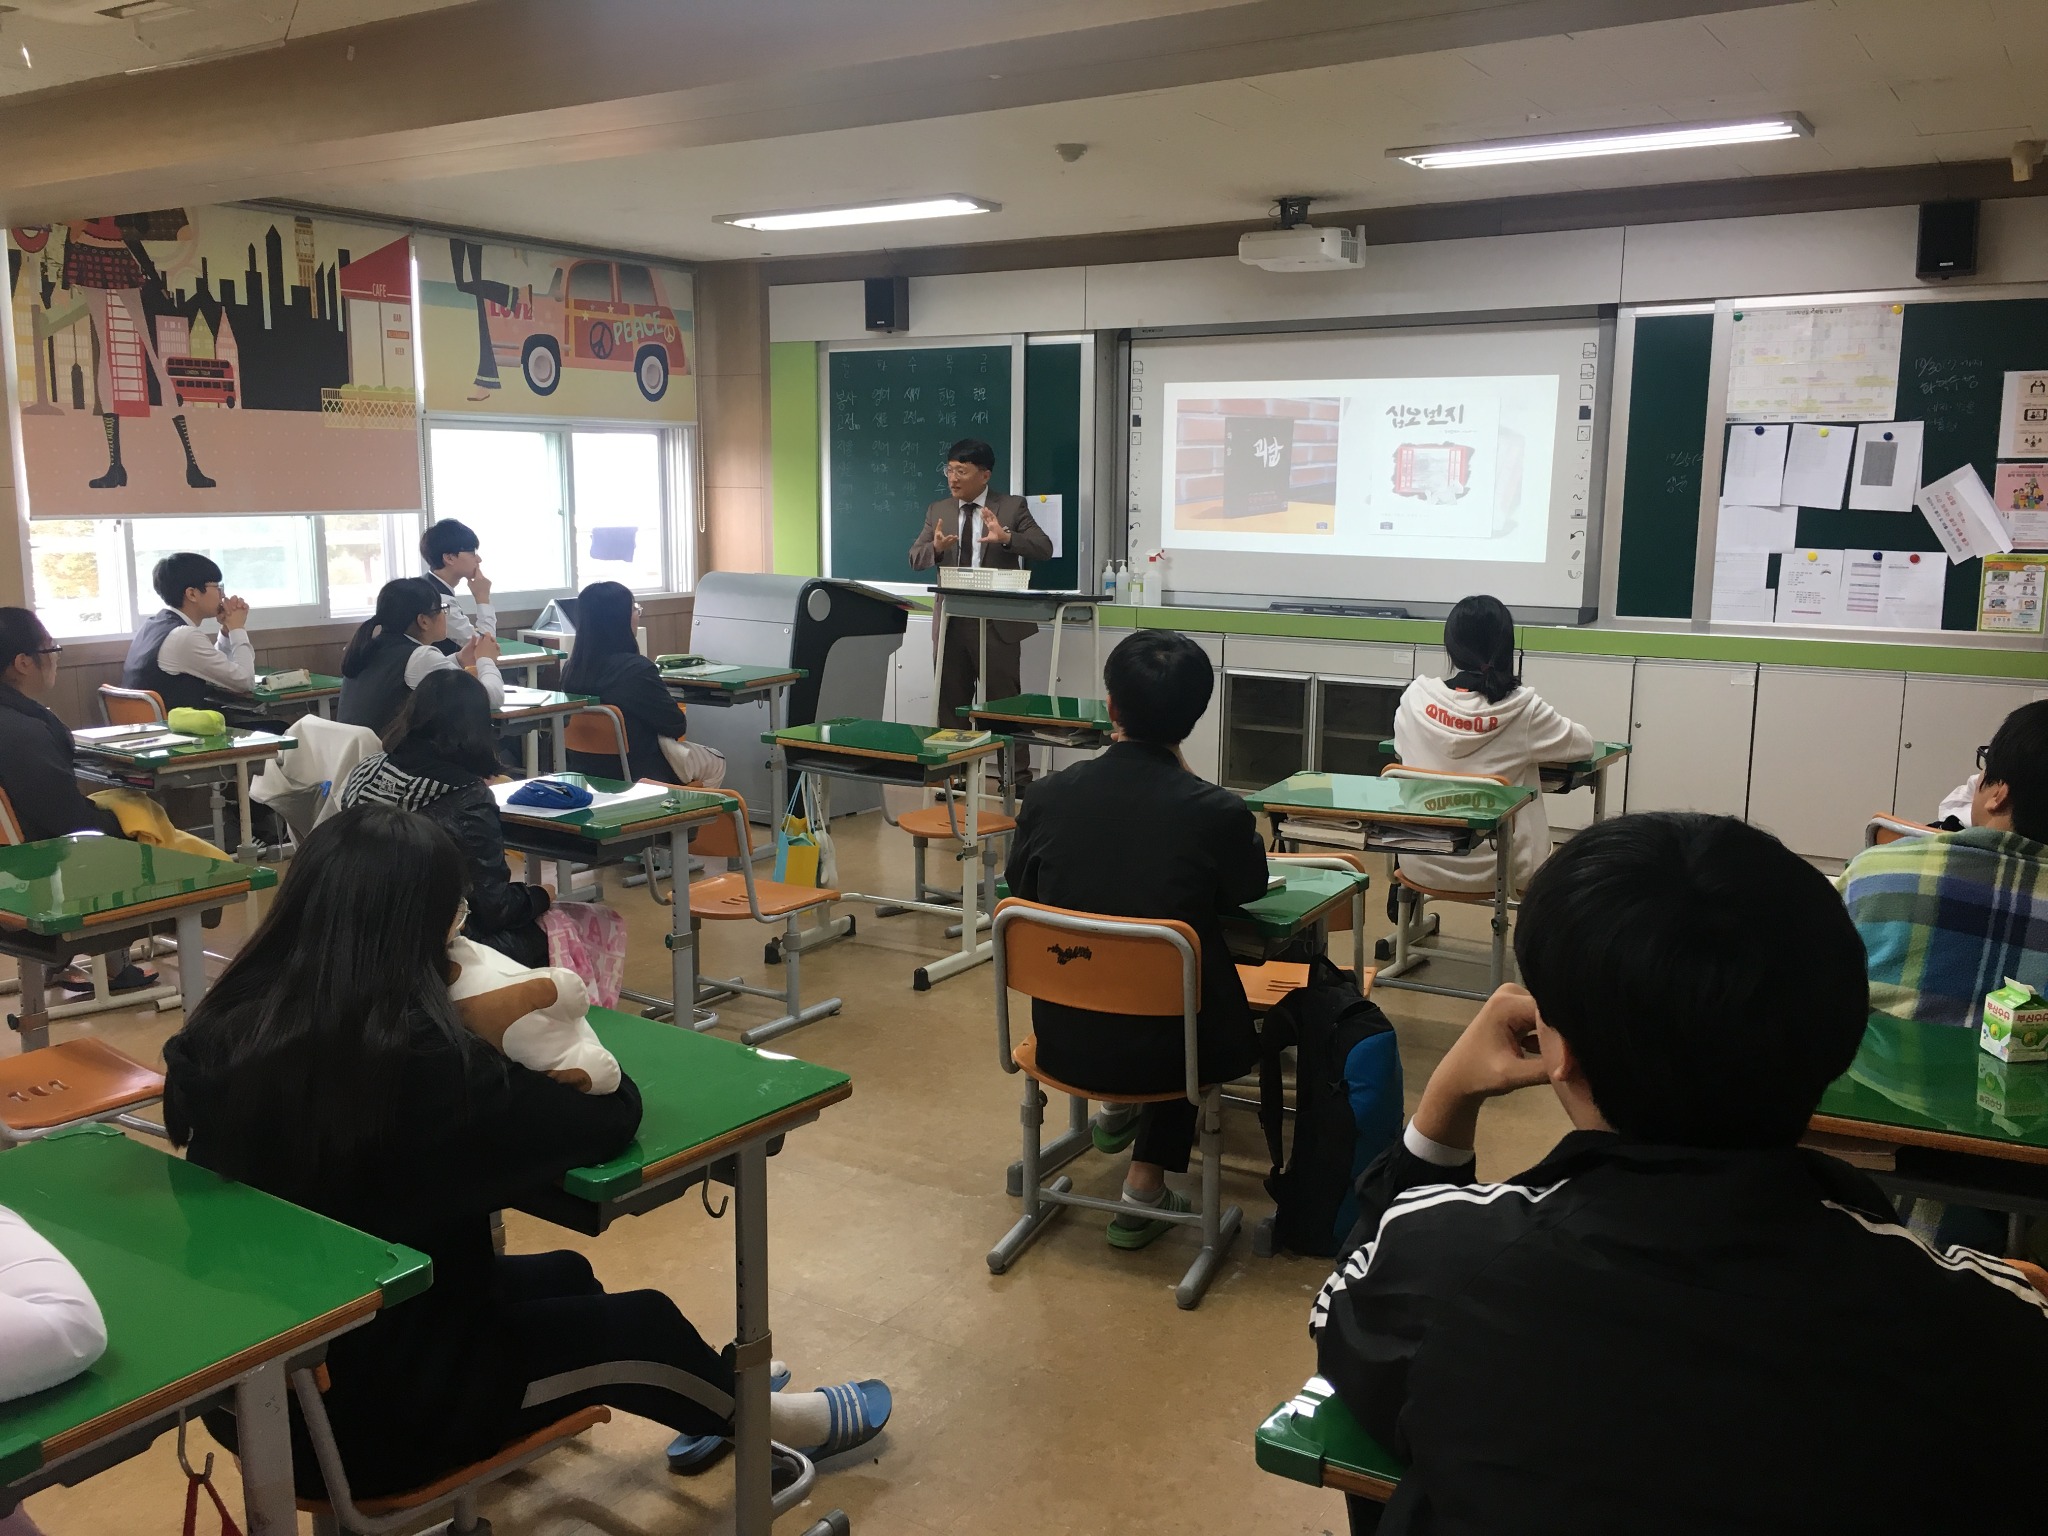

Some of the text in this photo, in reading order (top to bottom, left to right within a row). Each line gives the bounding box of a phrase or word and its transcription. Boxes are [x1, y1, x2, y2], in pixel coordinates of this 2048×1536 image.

[372, 283, 387, 298] CAFE
[613, 311, 665, 345] PEACE
[908, 356, 918, 373] 수
[1385, 404, 1464, 428] 십오번지
[1987, 1002, 2010, 1020] 부산우유
